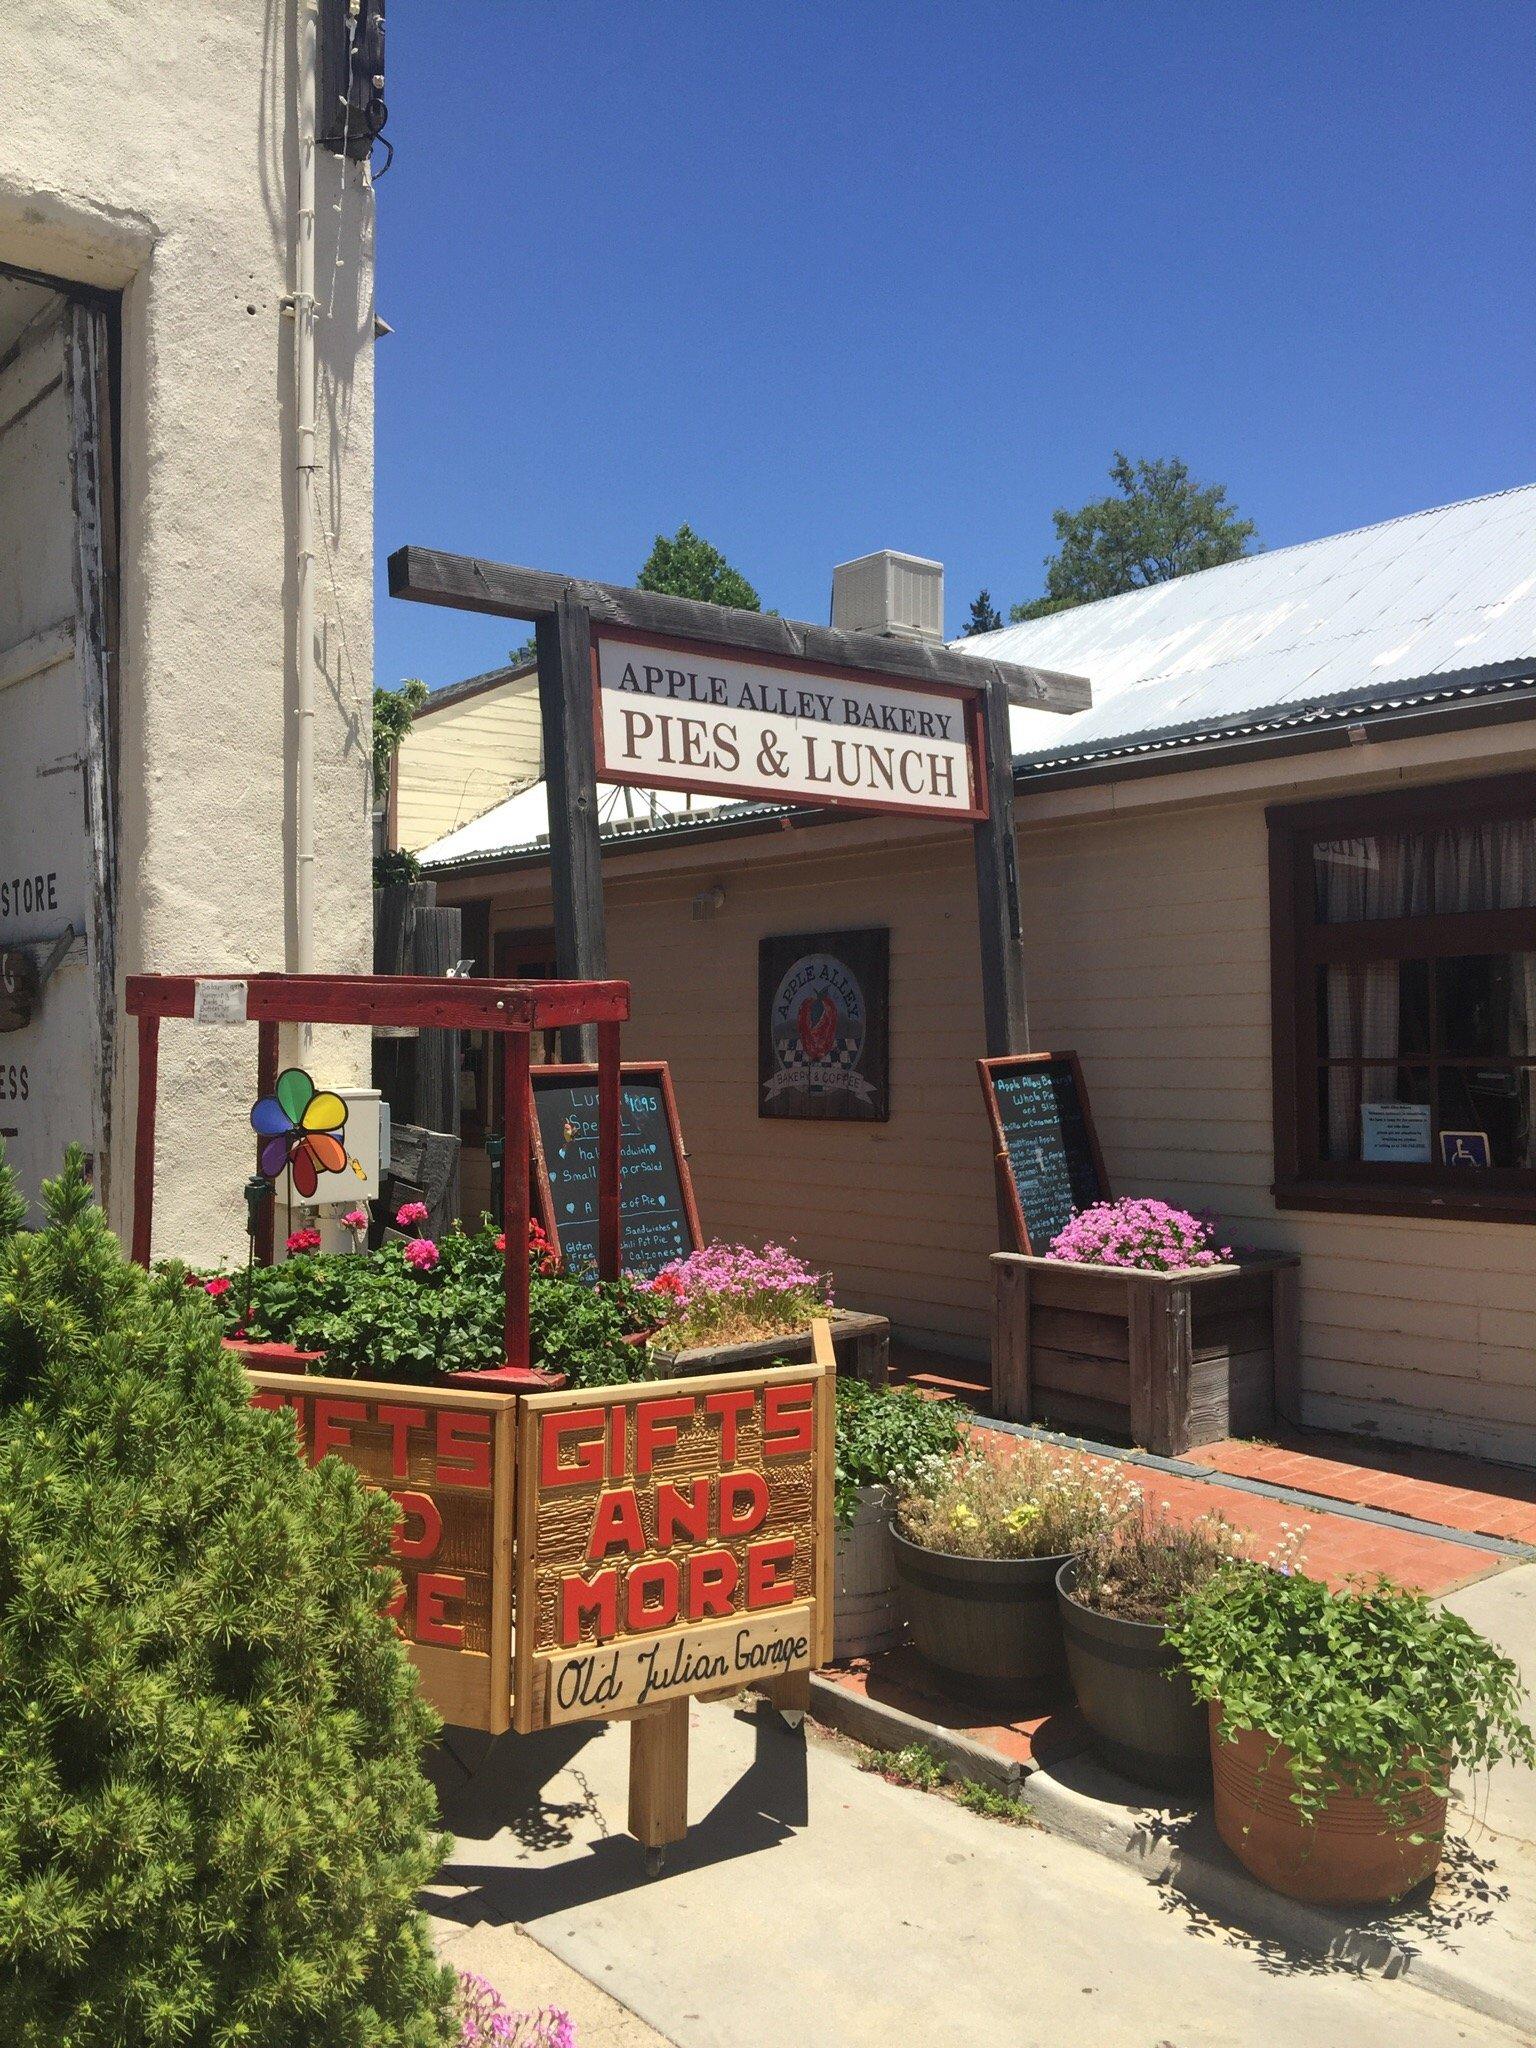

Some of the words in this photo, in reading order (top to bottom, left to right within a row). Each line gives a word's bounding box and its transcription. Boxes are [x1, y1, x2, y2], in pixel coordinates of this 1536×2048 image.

[618, 662, 728, 706] APPLE
[736, 682, 835, 722] ALLEY
[842, 698, 952, 740] BAKERY
[619, 709, 741, 773] PIES
[756, 729, 790, 778] &
[801, 735, 957, 798] LUNCH
[1, 872, 58, 917] STORE
[778, 965, 816, 1020] APPLE
[819, 964, 860, 1020] ALLEY
[997, 1079, 1021, 1092] Apple
[562, 1165, 598, 1182] Small
[641, 1194, 657, 1206] Pie
[625, 1223, 671, 1236] Sandwiches
[629, 1247, 676, 1261] Calzones
[638, 1236, 651, 1247] Pot
[653, 1234, 668, 1245] Pie
[250, 1393, 492, 1488] IFTS
[541, 1383, 815, 1487] GIFTS
[586, 1469, 771, 1559] AND
[561, 1537, 797, 1645] MORE
[556, 1650, 623, 1709] Old
[637, 1637, 729, 1705] Julian
[734, 1629, 808, 1673] Garage
